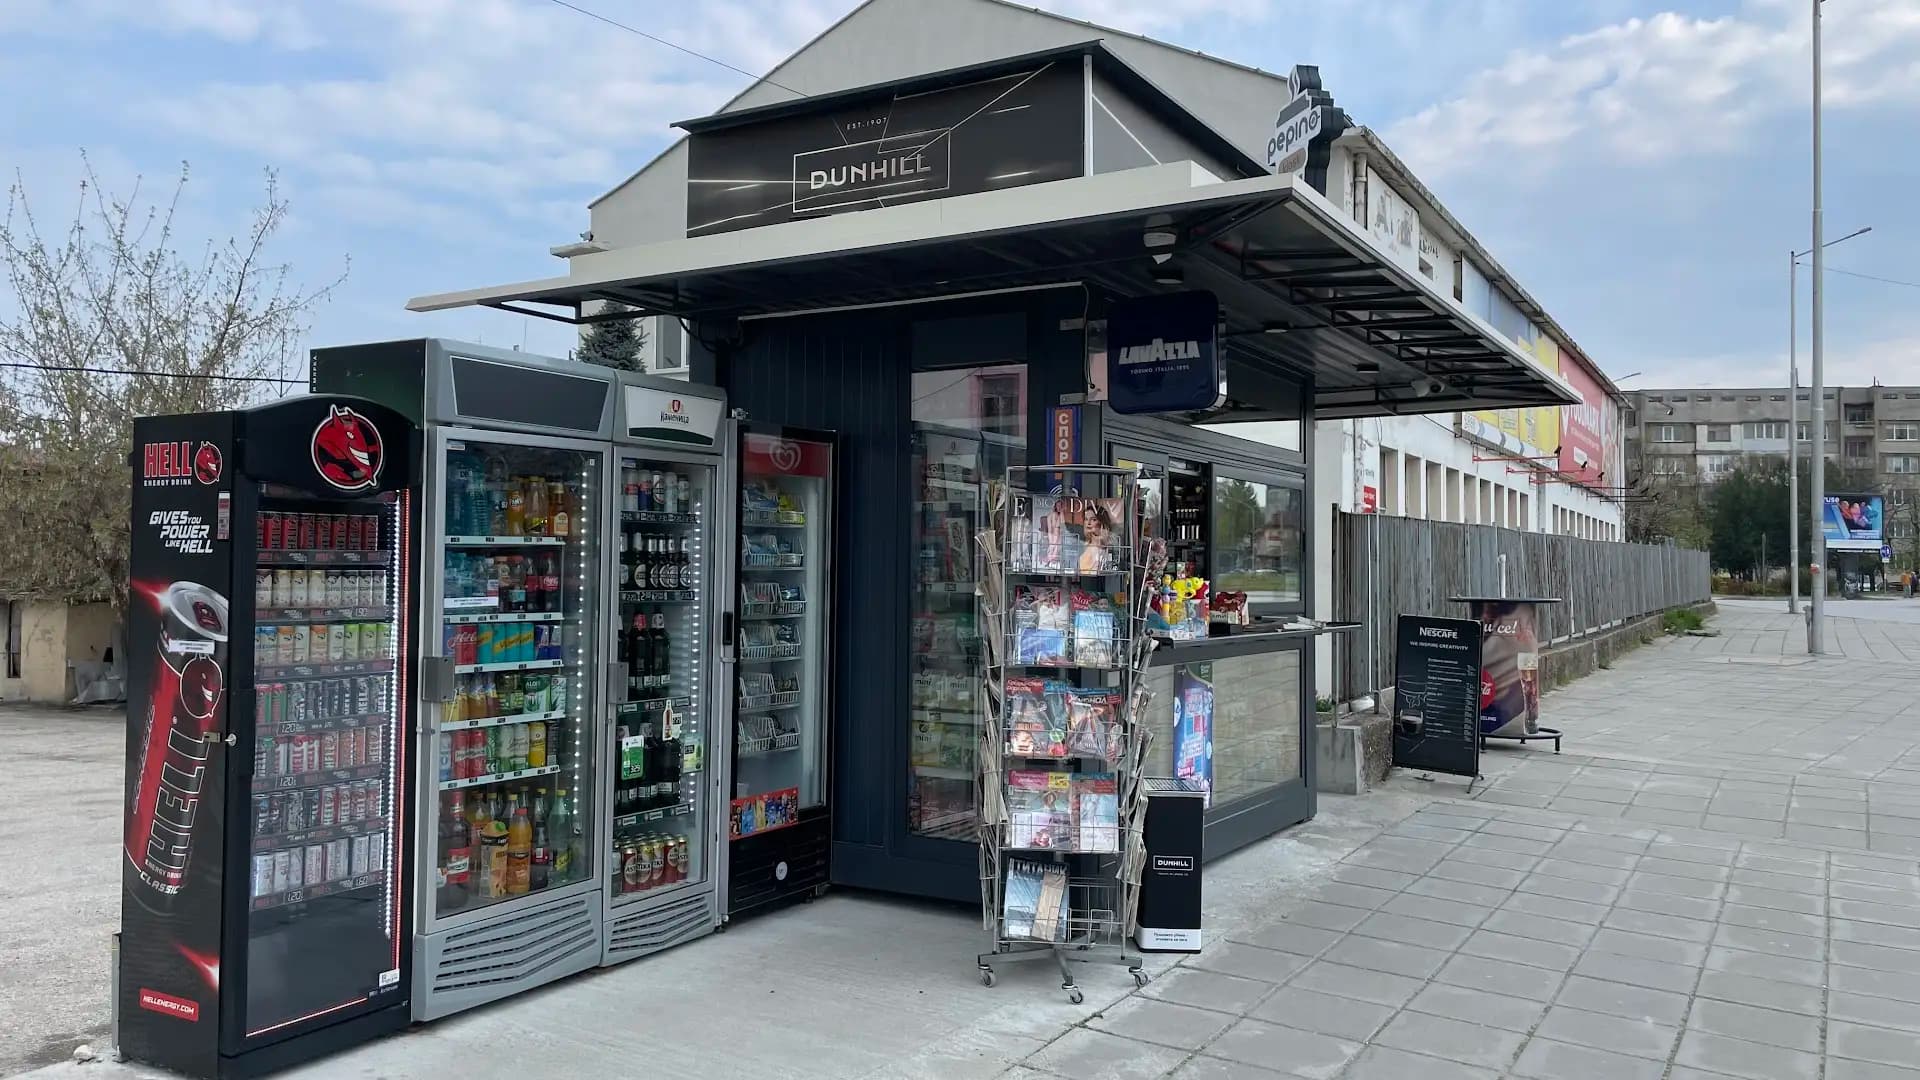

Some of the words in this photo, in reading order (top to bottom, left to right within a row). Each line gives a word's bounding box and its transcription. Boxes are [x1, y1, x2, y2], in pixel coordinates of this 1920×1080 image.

[1268, 110, 1320, 164] pepino
[810, 153, 931, 190] DUNHILL
[1118, 338, 1200, 365] LAVAZZA
[1058, 412, 1069, 464] СПОР
[144, 441, 192, 478] HELL
[144, 479, 169, 487] ENERGY
[171, 478, 192, 486] DRINK
[149, 511, 189, 525] GIVES
[187, 516, 202, 525] YOU
[160, 525, 210, 539] POWER
[165, 540, 181, 548] LIKE
[180, 540, 213, 554] HELL
[147, 728, 211, 870] HELL
[1157, 859, 1189, 867] DUNHILL
[140, 870, 181, 895] CLASSIC
[142, 995, 195, 1014] HELLENERGY.COM
